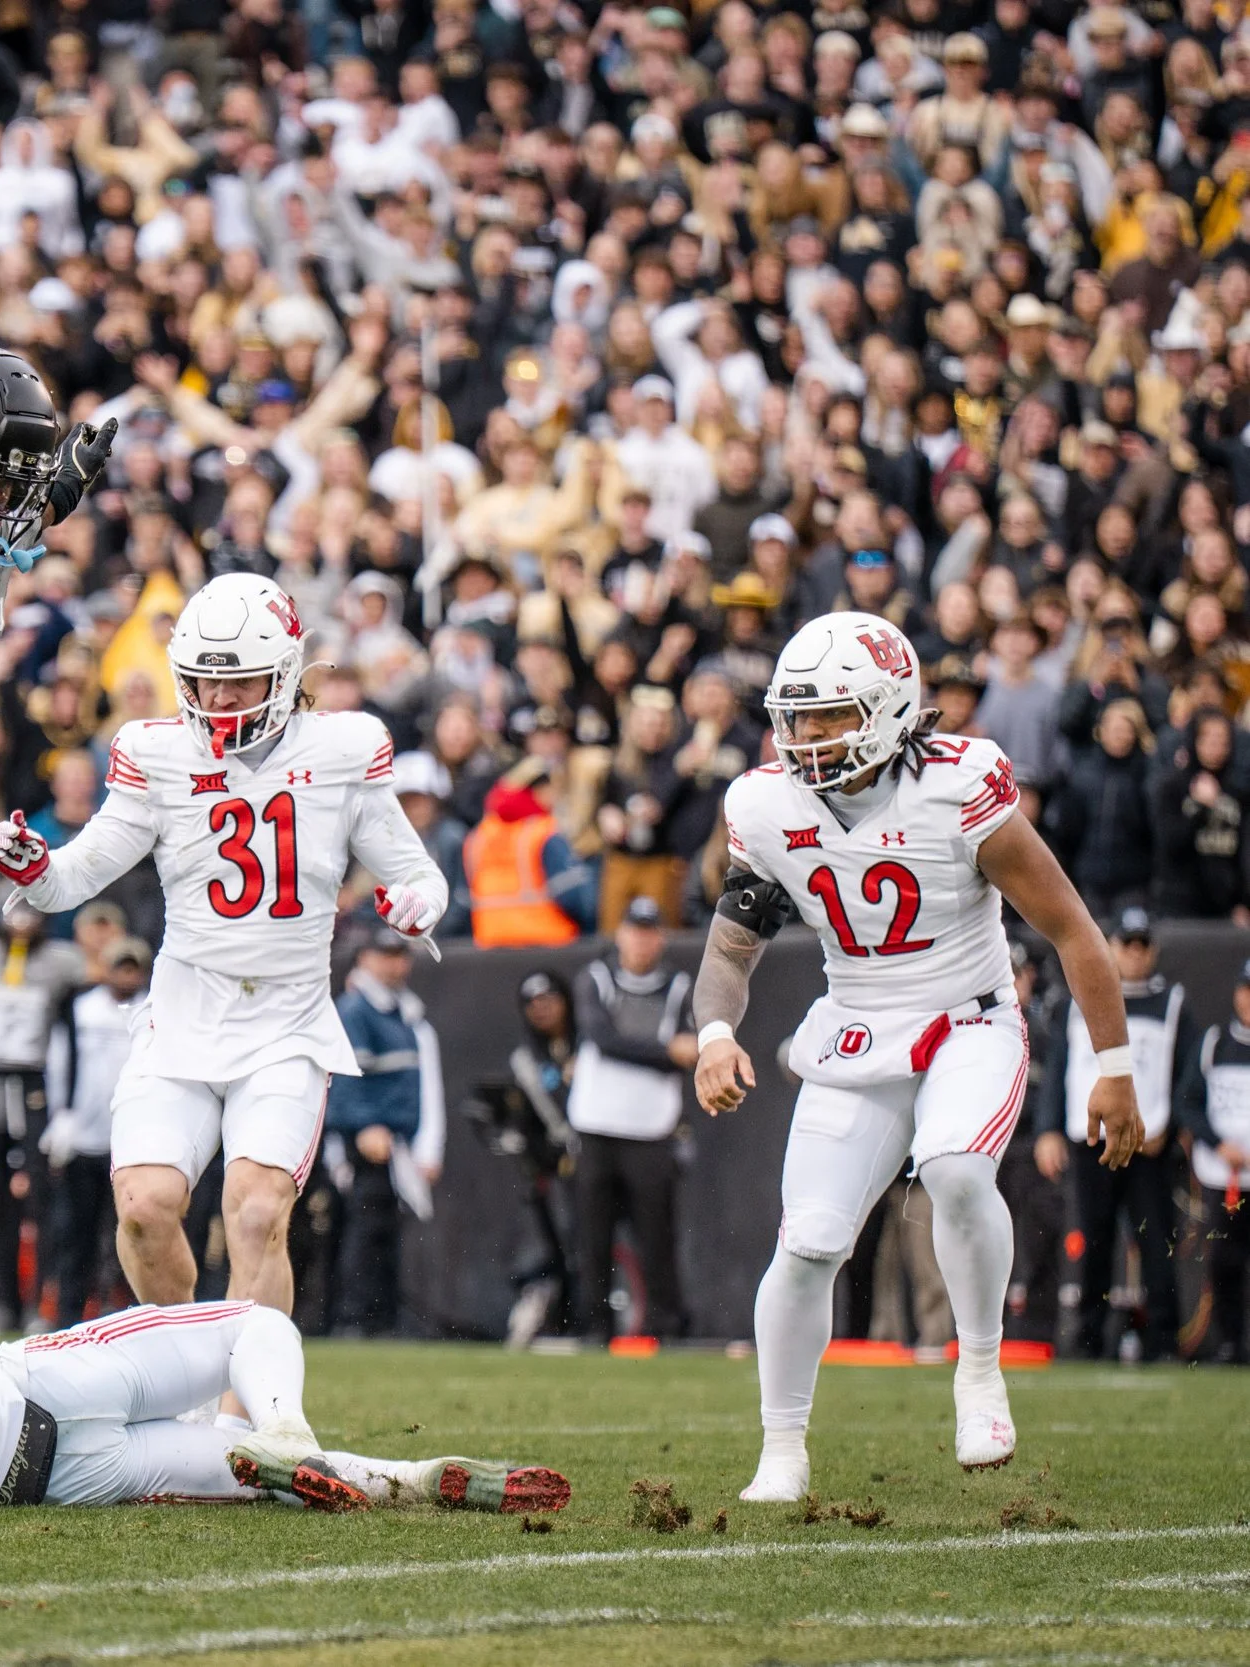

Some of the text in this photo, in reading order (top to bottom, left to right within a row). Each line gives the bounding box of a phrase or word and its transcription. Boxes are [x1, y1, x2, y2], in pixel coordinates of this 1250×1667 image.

[190, 770, 230, 796] XII
[782, 825, 823, 852] XII
[207, 791, 304, 920] 31
[807, 860, 936, 958] 12
[839, 1030, 867, 1054] U
